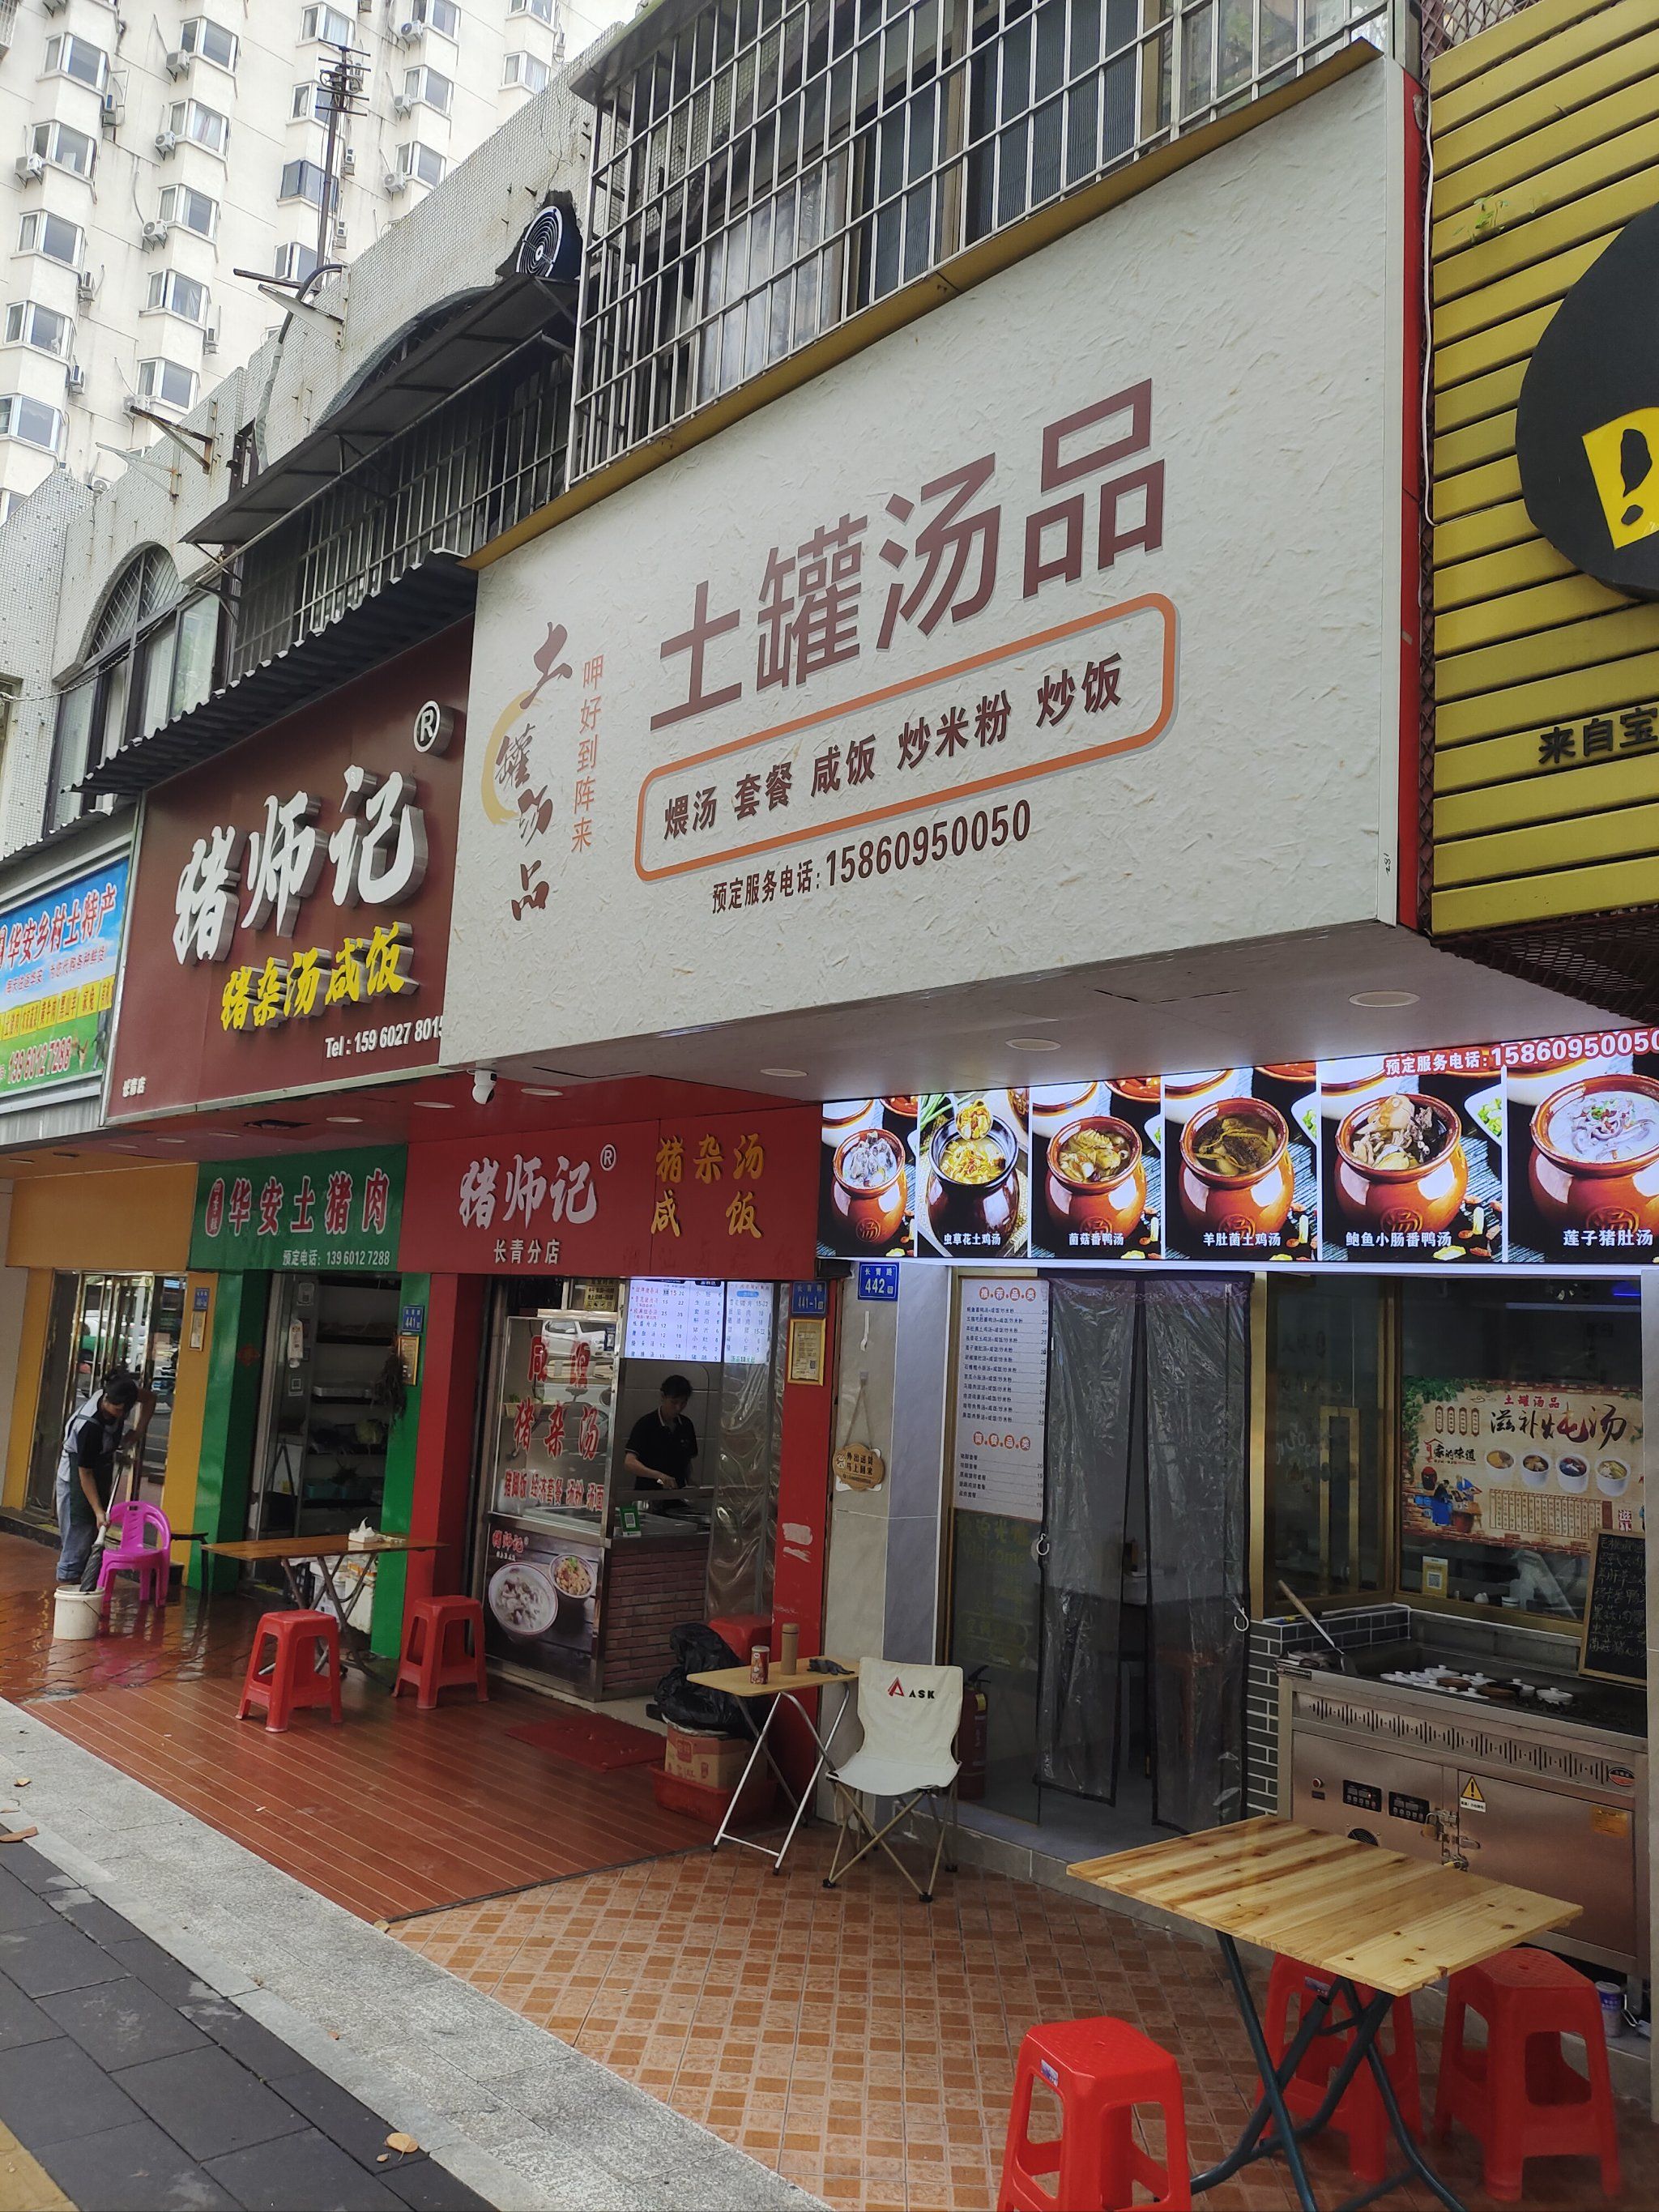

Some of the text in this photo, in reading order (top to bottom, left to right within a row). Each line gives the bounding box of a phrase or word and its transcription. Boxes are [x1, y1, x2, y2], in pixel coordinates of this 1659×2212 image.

[650, 378, 1165, 731] 土罐汤品
[571, 654, 604, 854] 呷好到阵来
[663, 652, 1123, 840] 煨汤 套餐 咸饭 炒米粉 炒饭
[1538, 707, 1659, 764] 来自宝
[495, 622, 573, 921] 土罐汤品
[172, 764, 416, 965] 猪师记
[6, 882, 117, 970] 华安乡村土特产
[221, 922, 407, 1033] 猪杂汤咸饭
[655, 1133, 765, 1184] 猪杂汤
[228, 1167, 390, 1237] 华安土猪肉
[459, 1153, 597, 1230] 猪师记
[493, 1238, 561, 1264] 长青分店
[943, 1232, 1001, 1246] 虫草花土鸡汤
[1068, 1232, 1124, 1246] 菌菇番鸭汤
[1202, 1231, 1281, 1247] 羊肚菌土鸡汤
[1346, 1230, 1452, 1247] 鲍鱼小肠番鸭汤
[1563, 1229, 1654, 1247] 莲子猪肚汤
[514, 1396, 600, 1461] 猪杂汤
[1491, 1401, 1627, 1451] 滋补炖汤
[1503, 1394, 1560, 1409] 土罐汤品
[1433, 1443, 1476, 1462] 家的味道
[908, 1690, 935, 1699] ASK
